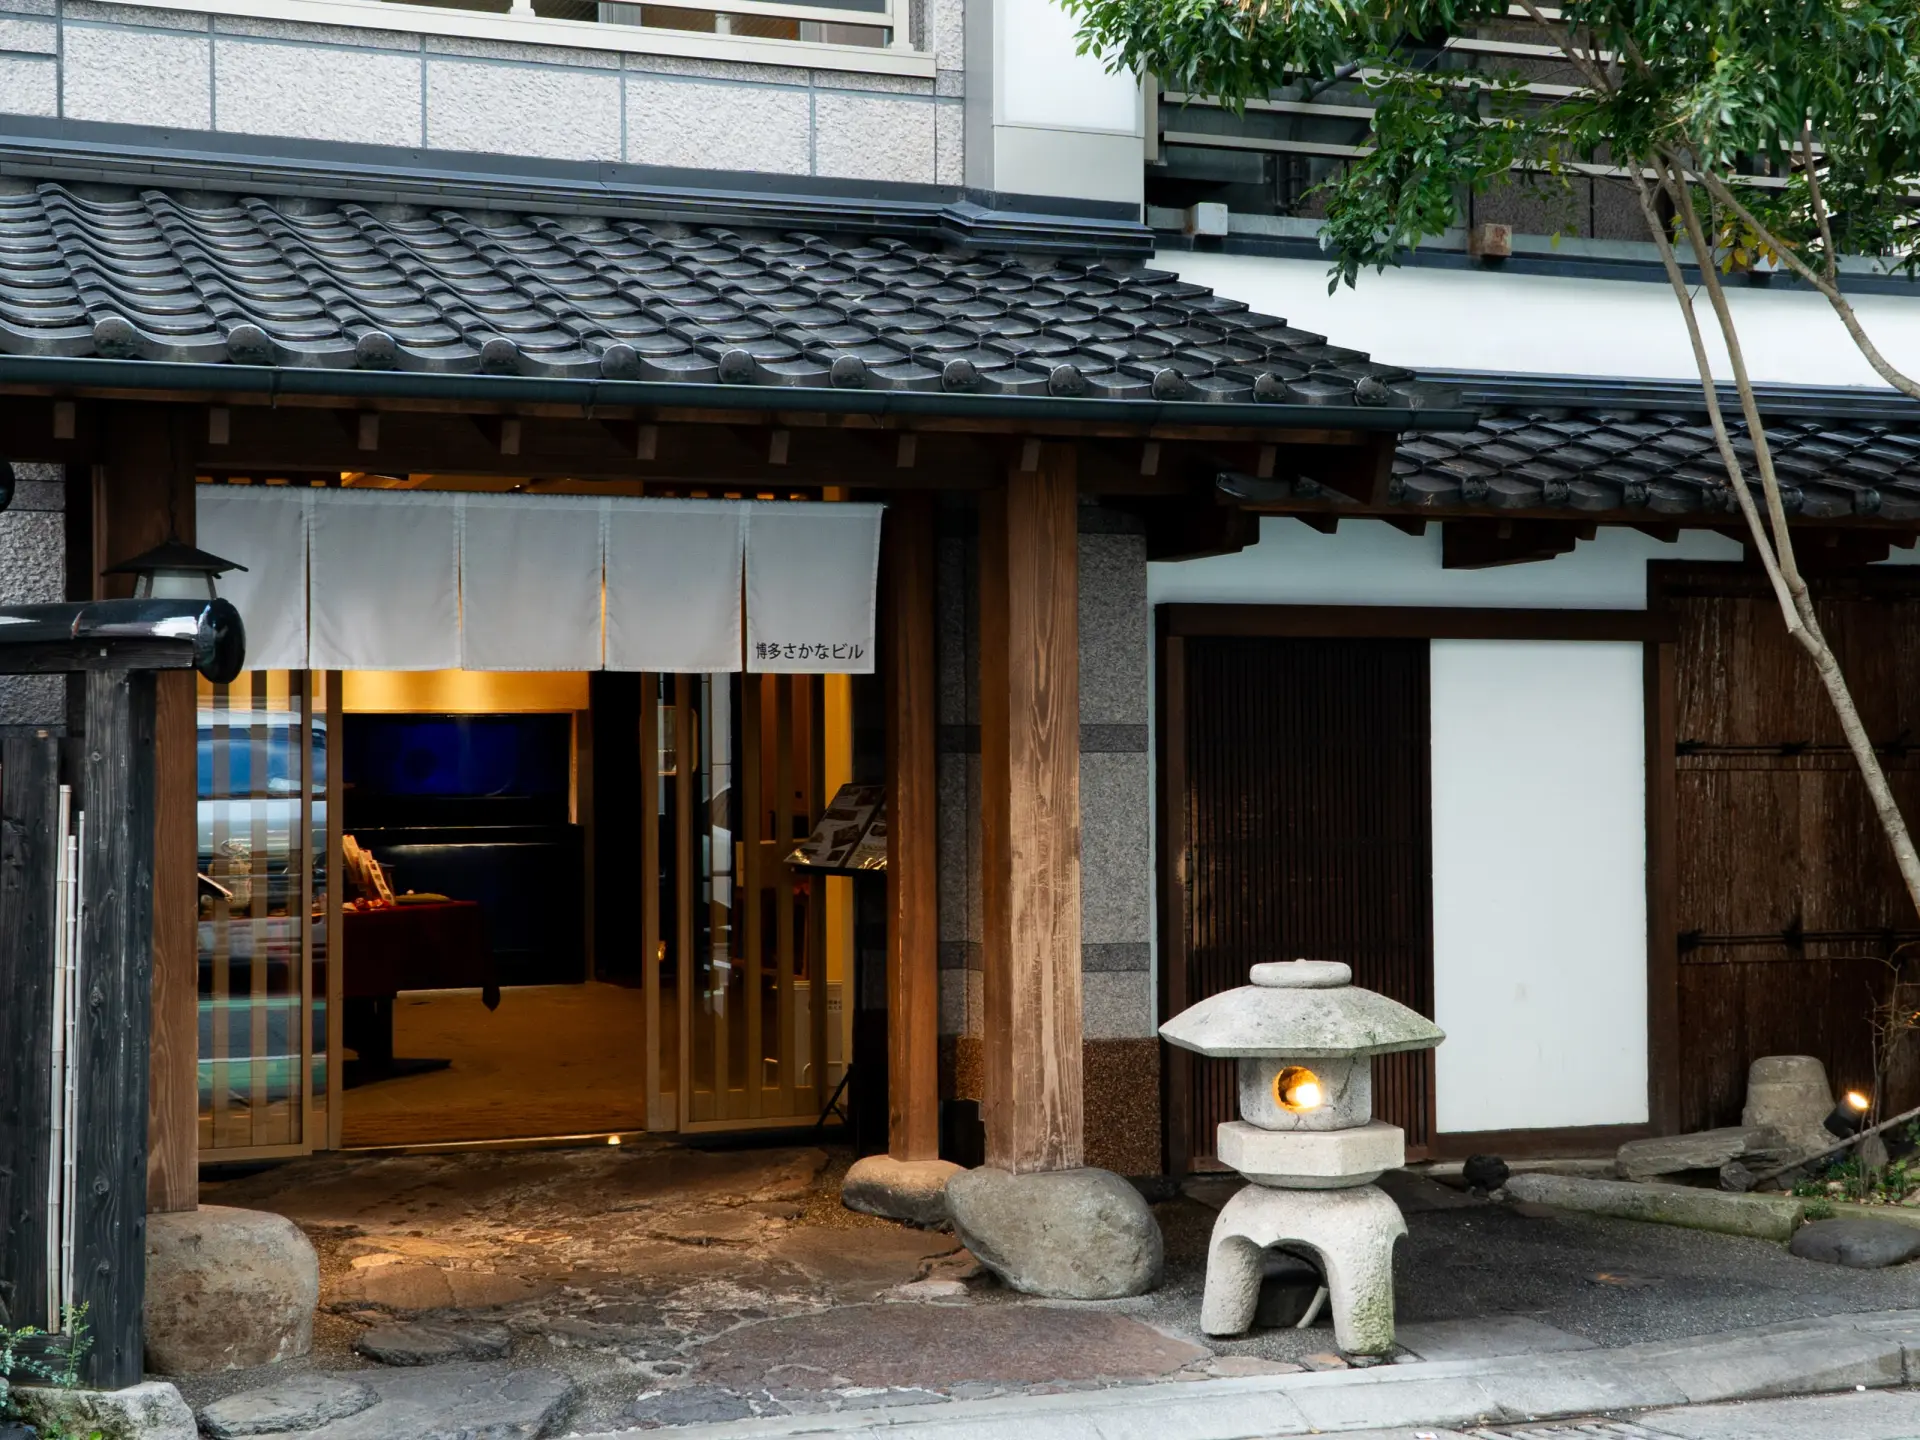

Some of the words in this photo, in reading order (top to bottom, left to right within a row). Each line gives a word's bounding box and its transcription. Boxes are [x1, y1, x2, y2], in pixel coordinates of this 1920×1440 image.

[755, 642, 864, 660] 博多さかなビル
